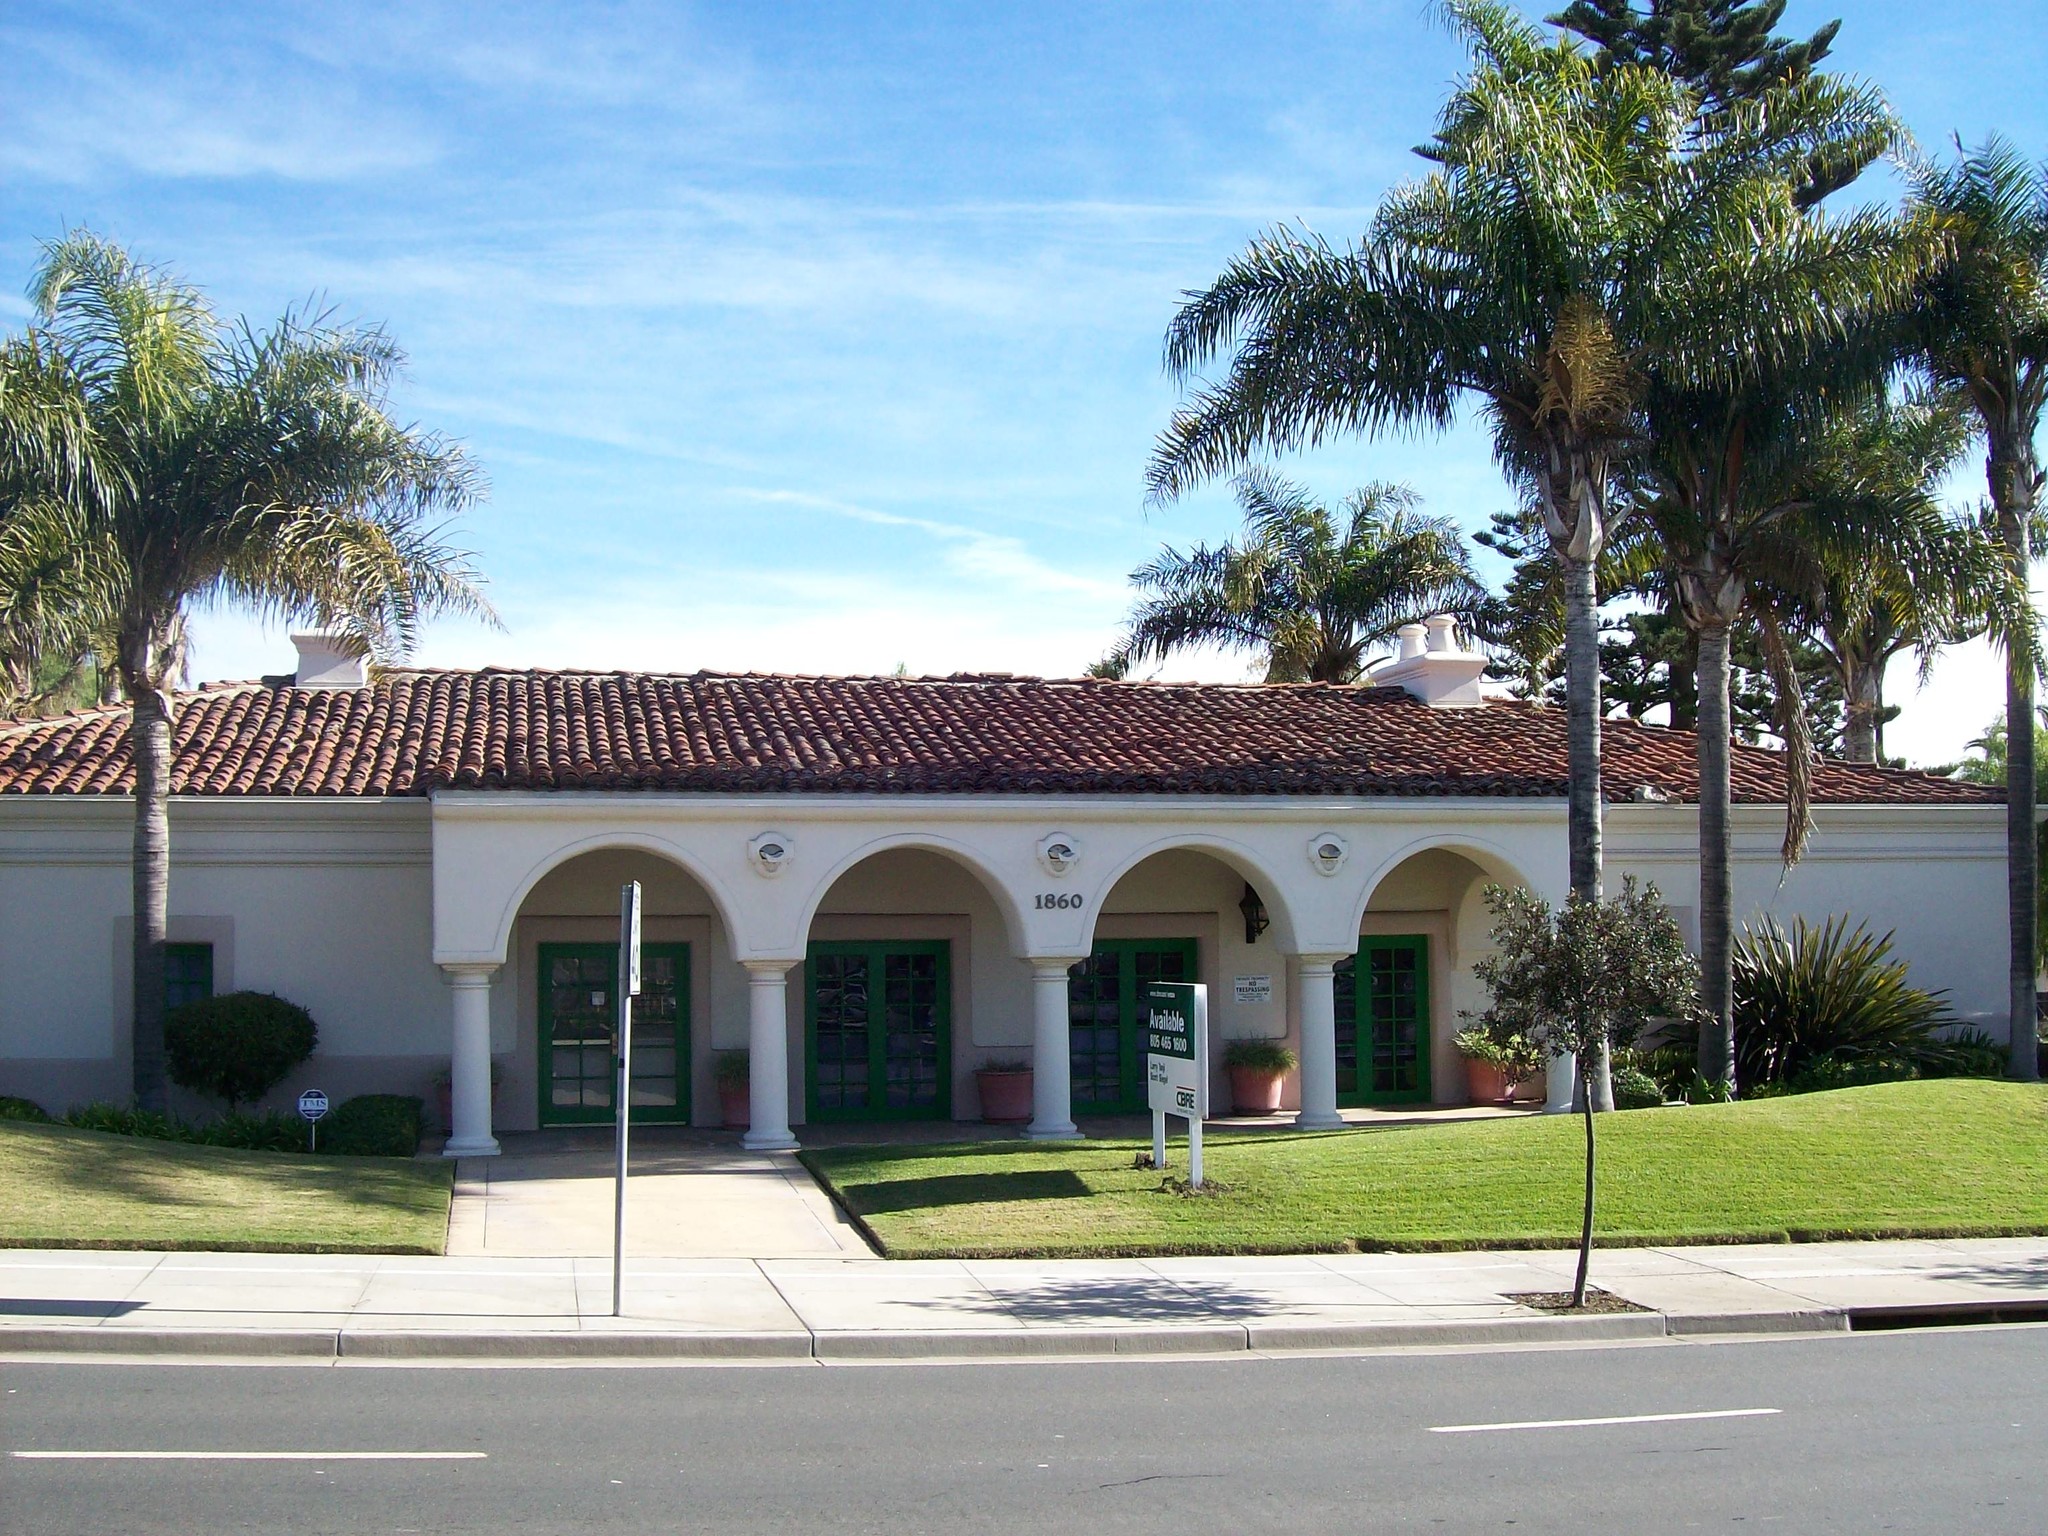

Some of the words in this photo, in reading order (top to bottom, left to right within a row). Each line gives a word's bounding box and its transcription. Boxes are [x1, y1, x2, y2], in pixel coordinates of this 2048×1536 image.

[1035, 893, 1083, 909] 1860
[1149, 1008, 1185, 1033] Available
[1150, 1034, 1160, 1048] 805
[301, 1099, 326, 1107] TMS
[1176, 1091, 1194, 1109] CBRE
